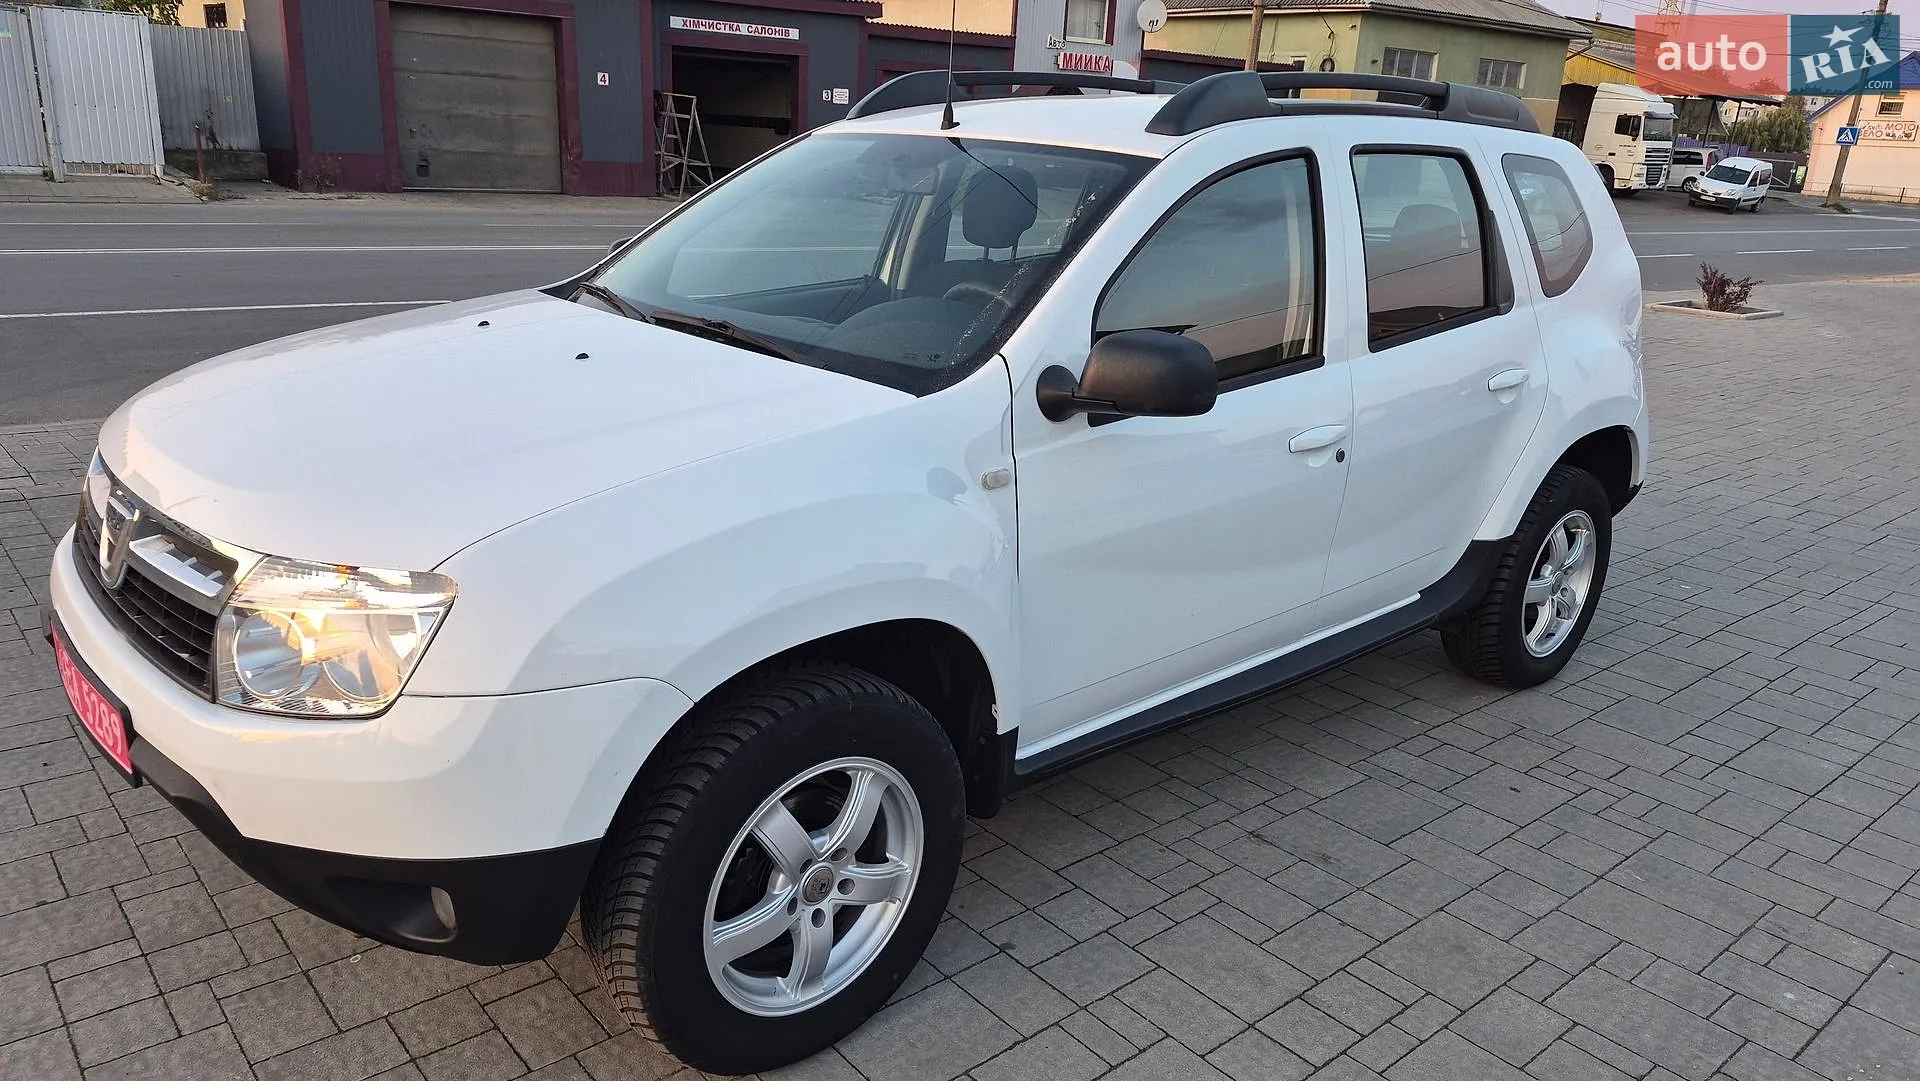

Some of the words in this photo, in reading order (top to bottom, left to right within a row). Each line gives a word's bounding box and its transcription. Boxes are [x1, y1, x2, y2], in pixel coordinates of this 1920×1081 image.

[681, 18, 742, 33] ХІМЧИСТКА
[746, 25, 791, 38] САЛОНІВ
[600, 73, 607, 85] 4
[824, 90, 830, 100] 3
[81, 679, 122, 755] 5289
